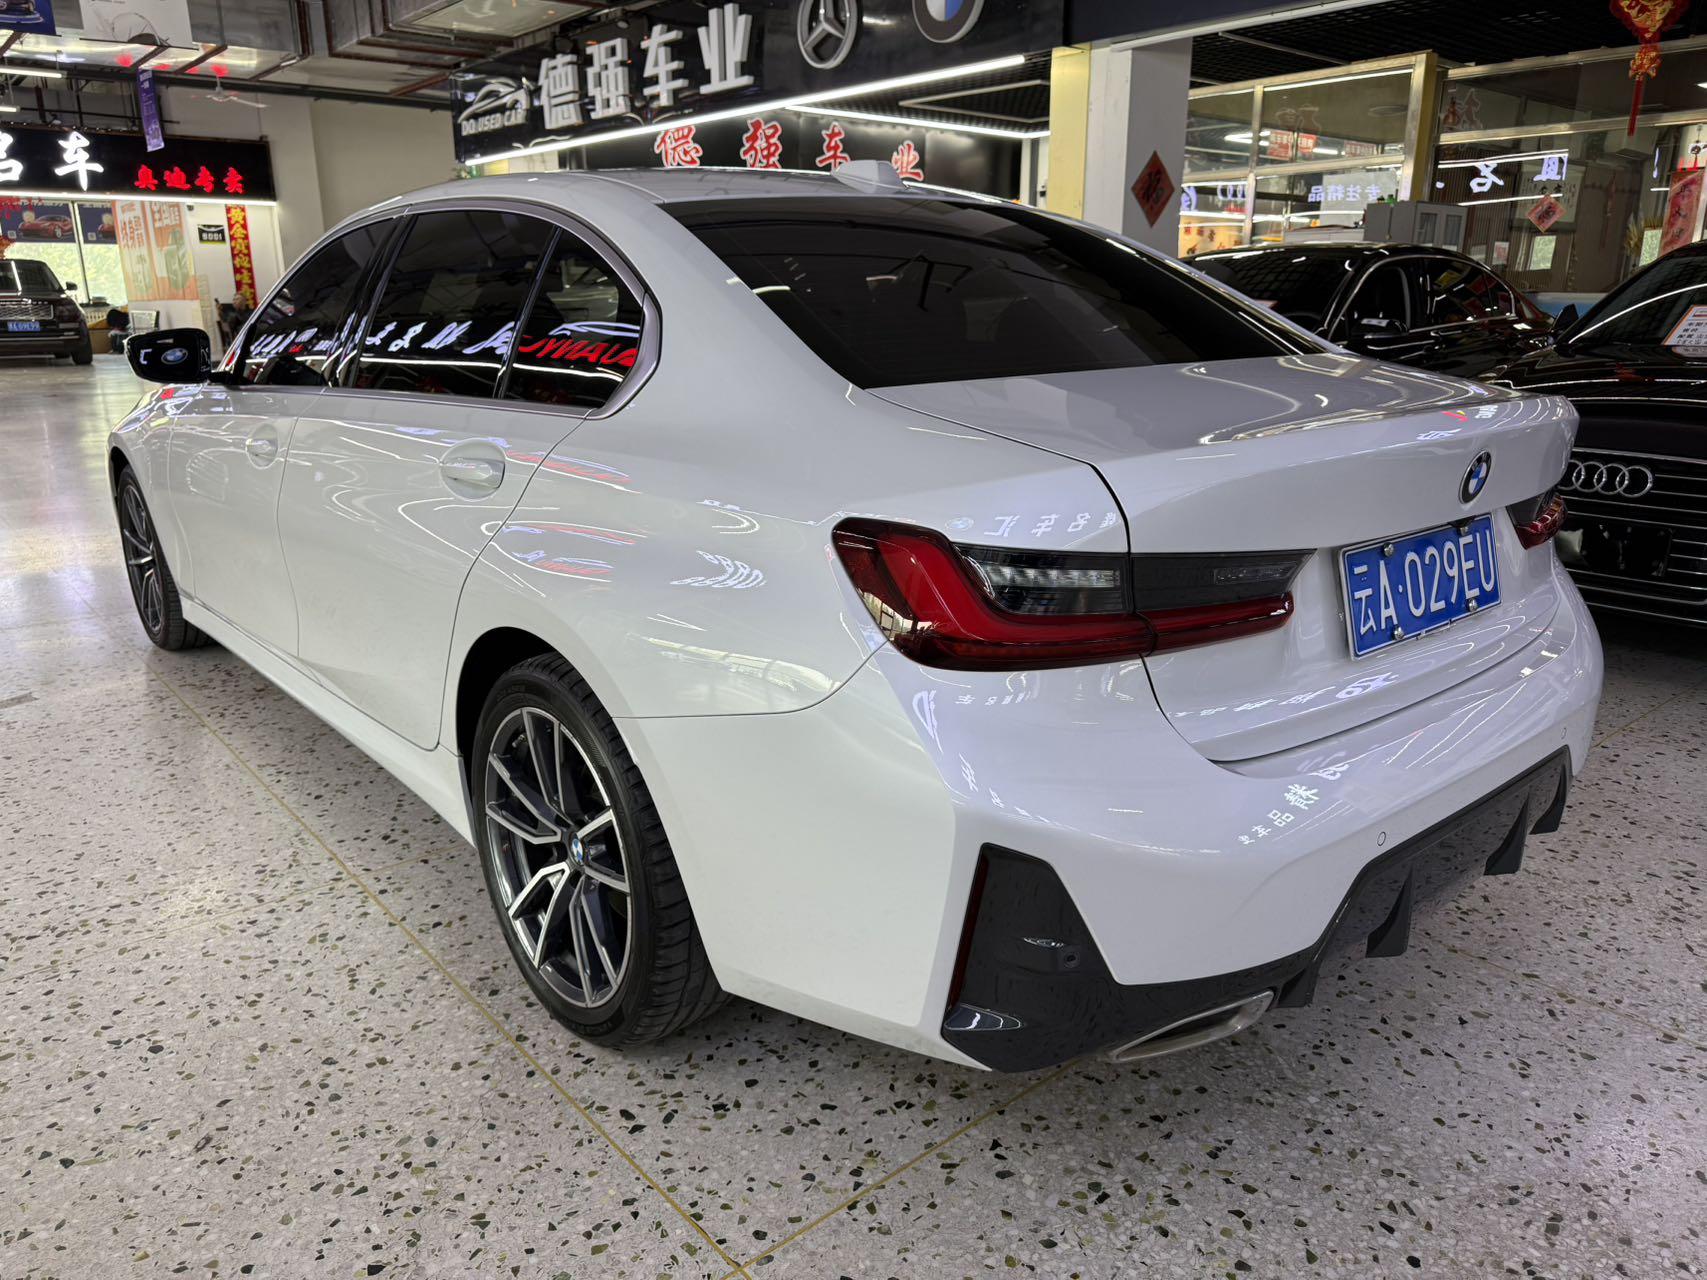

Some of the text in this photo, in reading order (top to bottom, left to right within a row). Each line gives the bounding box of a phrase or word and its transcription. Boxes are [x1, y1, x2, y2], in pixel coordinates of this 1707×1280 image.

[538, 3, 754, 130] 德强车业
[654, 118, 924, 182] 德强车业
[1354, 529, 1495, 635] 云A·029EU
